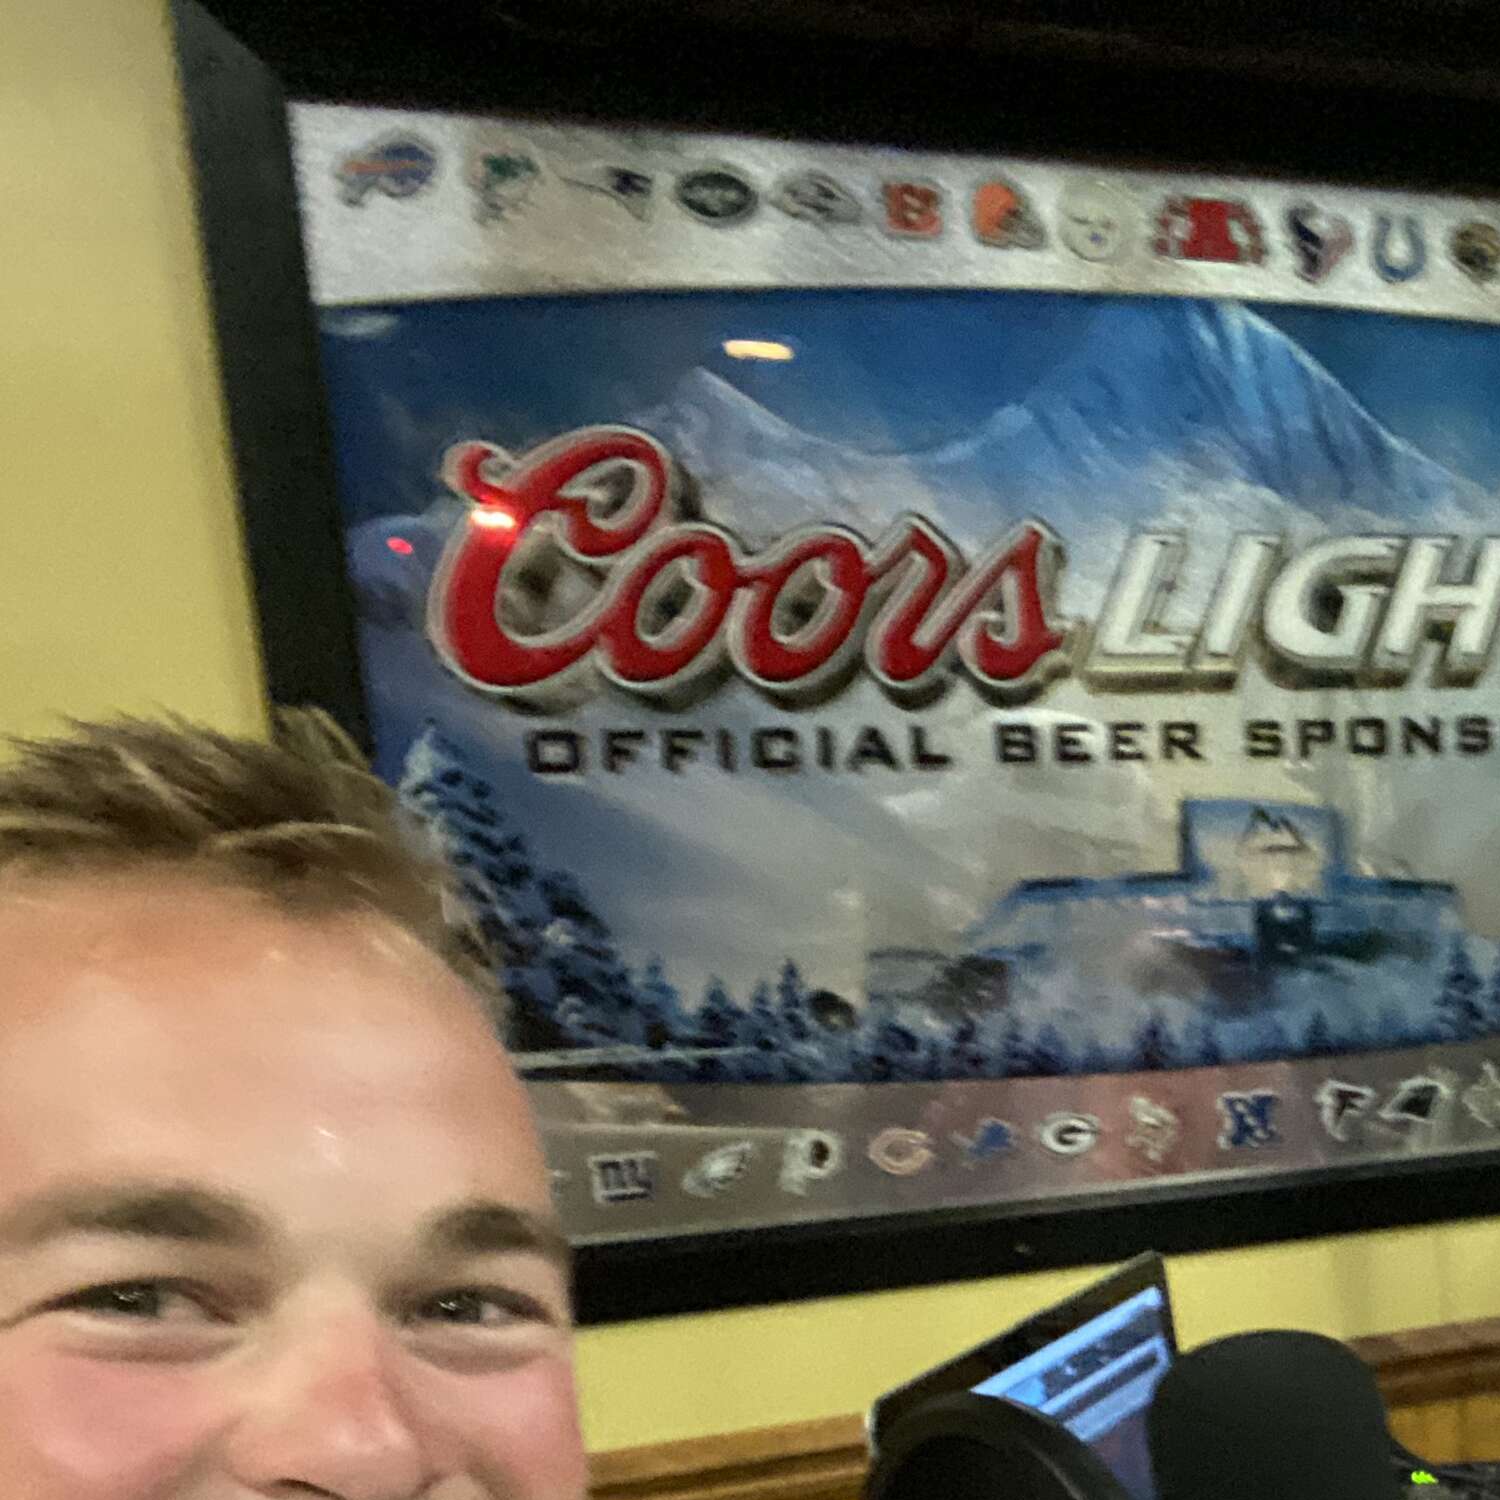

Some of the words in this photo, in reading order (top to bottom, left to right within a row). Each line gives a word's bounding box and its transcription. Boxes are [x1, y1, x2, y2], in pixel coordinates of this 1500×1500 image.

[427, 424, 1070, 697] Coors
[526, 724, 953, 775] OFFICIAL
[996, 719, 1206, 764] BEER
